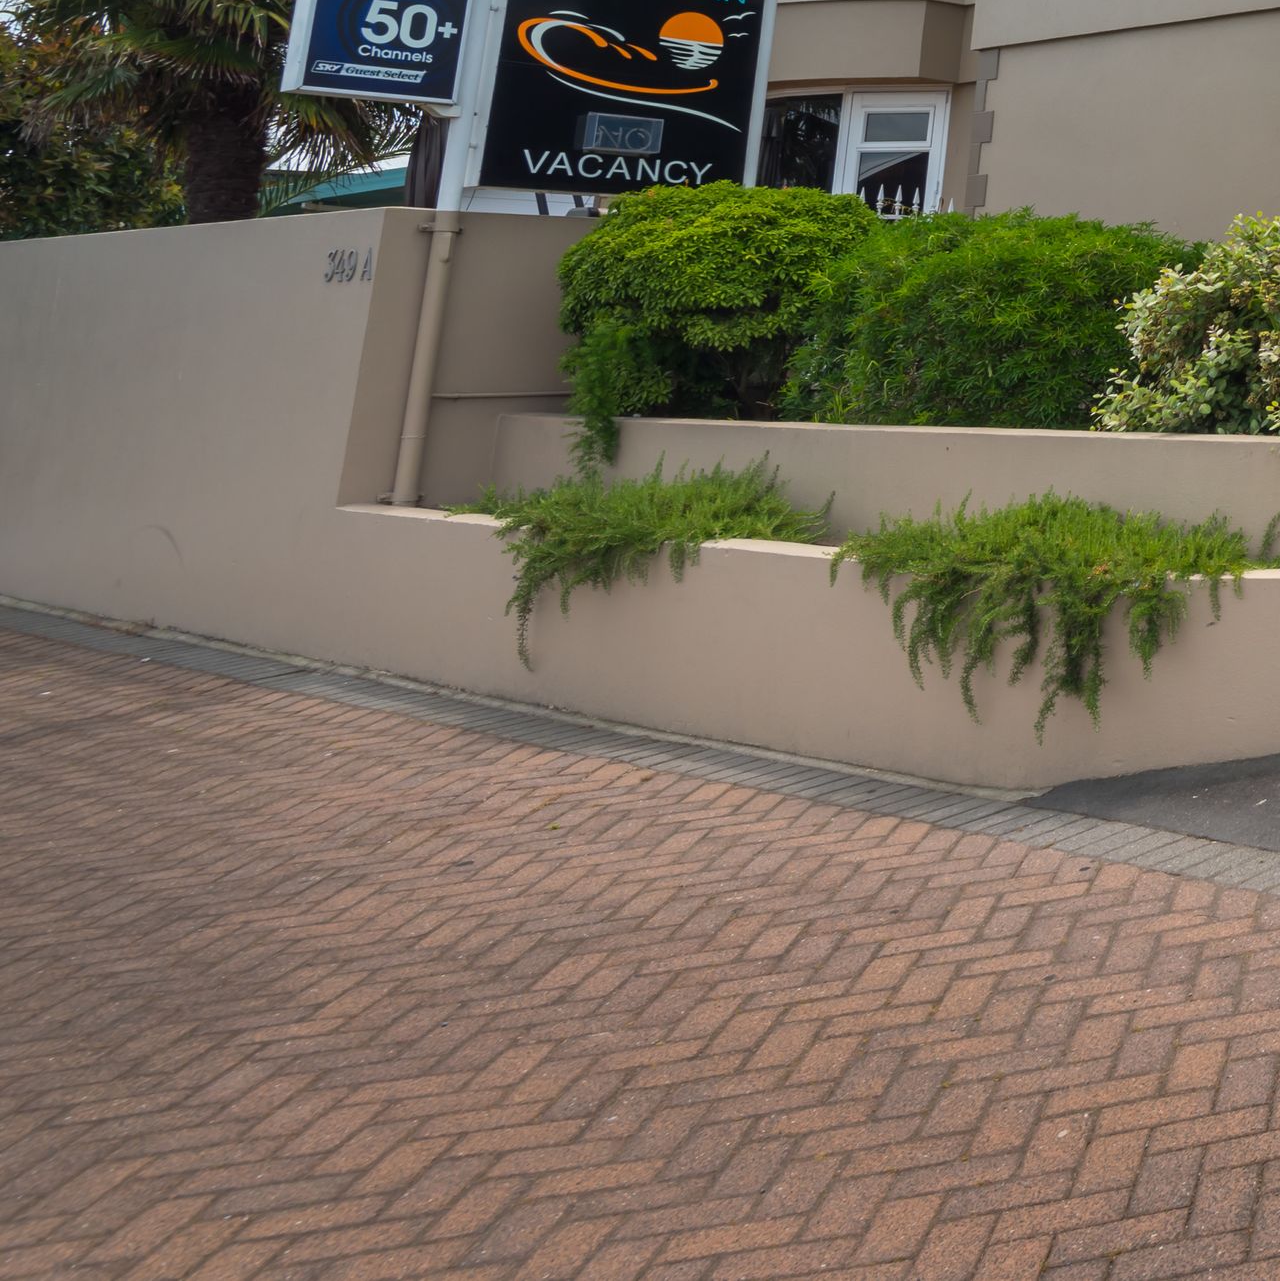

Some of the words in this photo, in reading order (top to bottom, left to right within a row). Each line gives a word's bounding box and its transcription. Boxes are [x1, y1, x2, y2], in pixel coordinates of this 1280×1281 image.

[357, 44, 434, 64] Channels
[314, 63, 342, 72] SKY
[344, 65, 381, 77] Guest
[382, 70, 420, 81] Select
[522, 148, 714, 186] VACANCY
